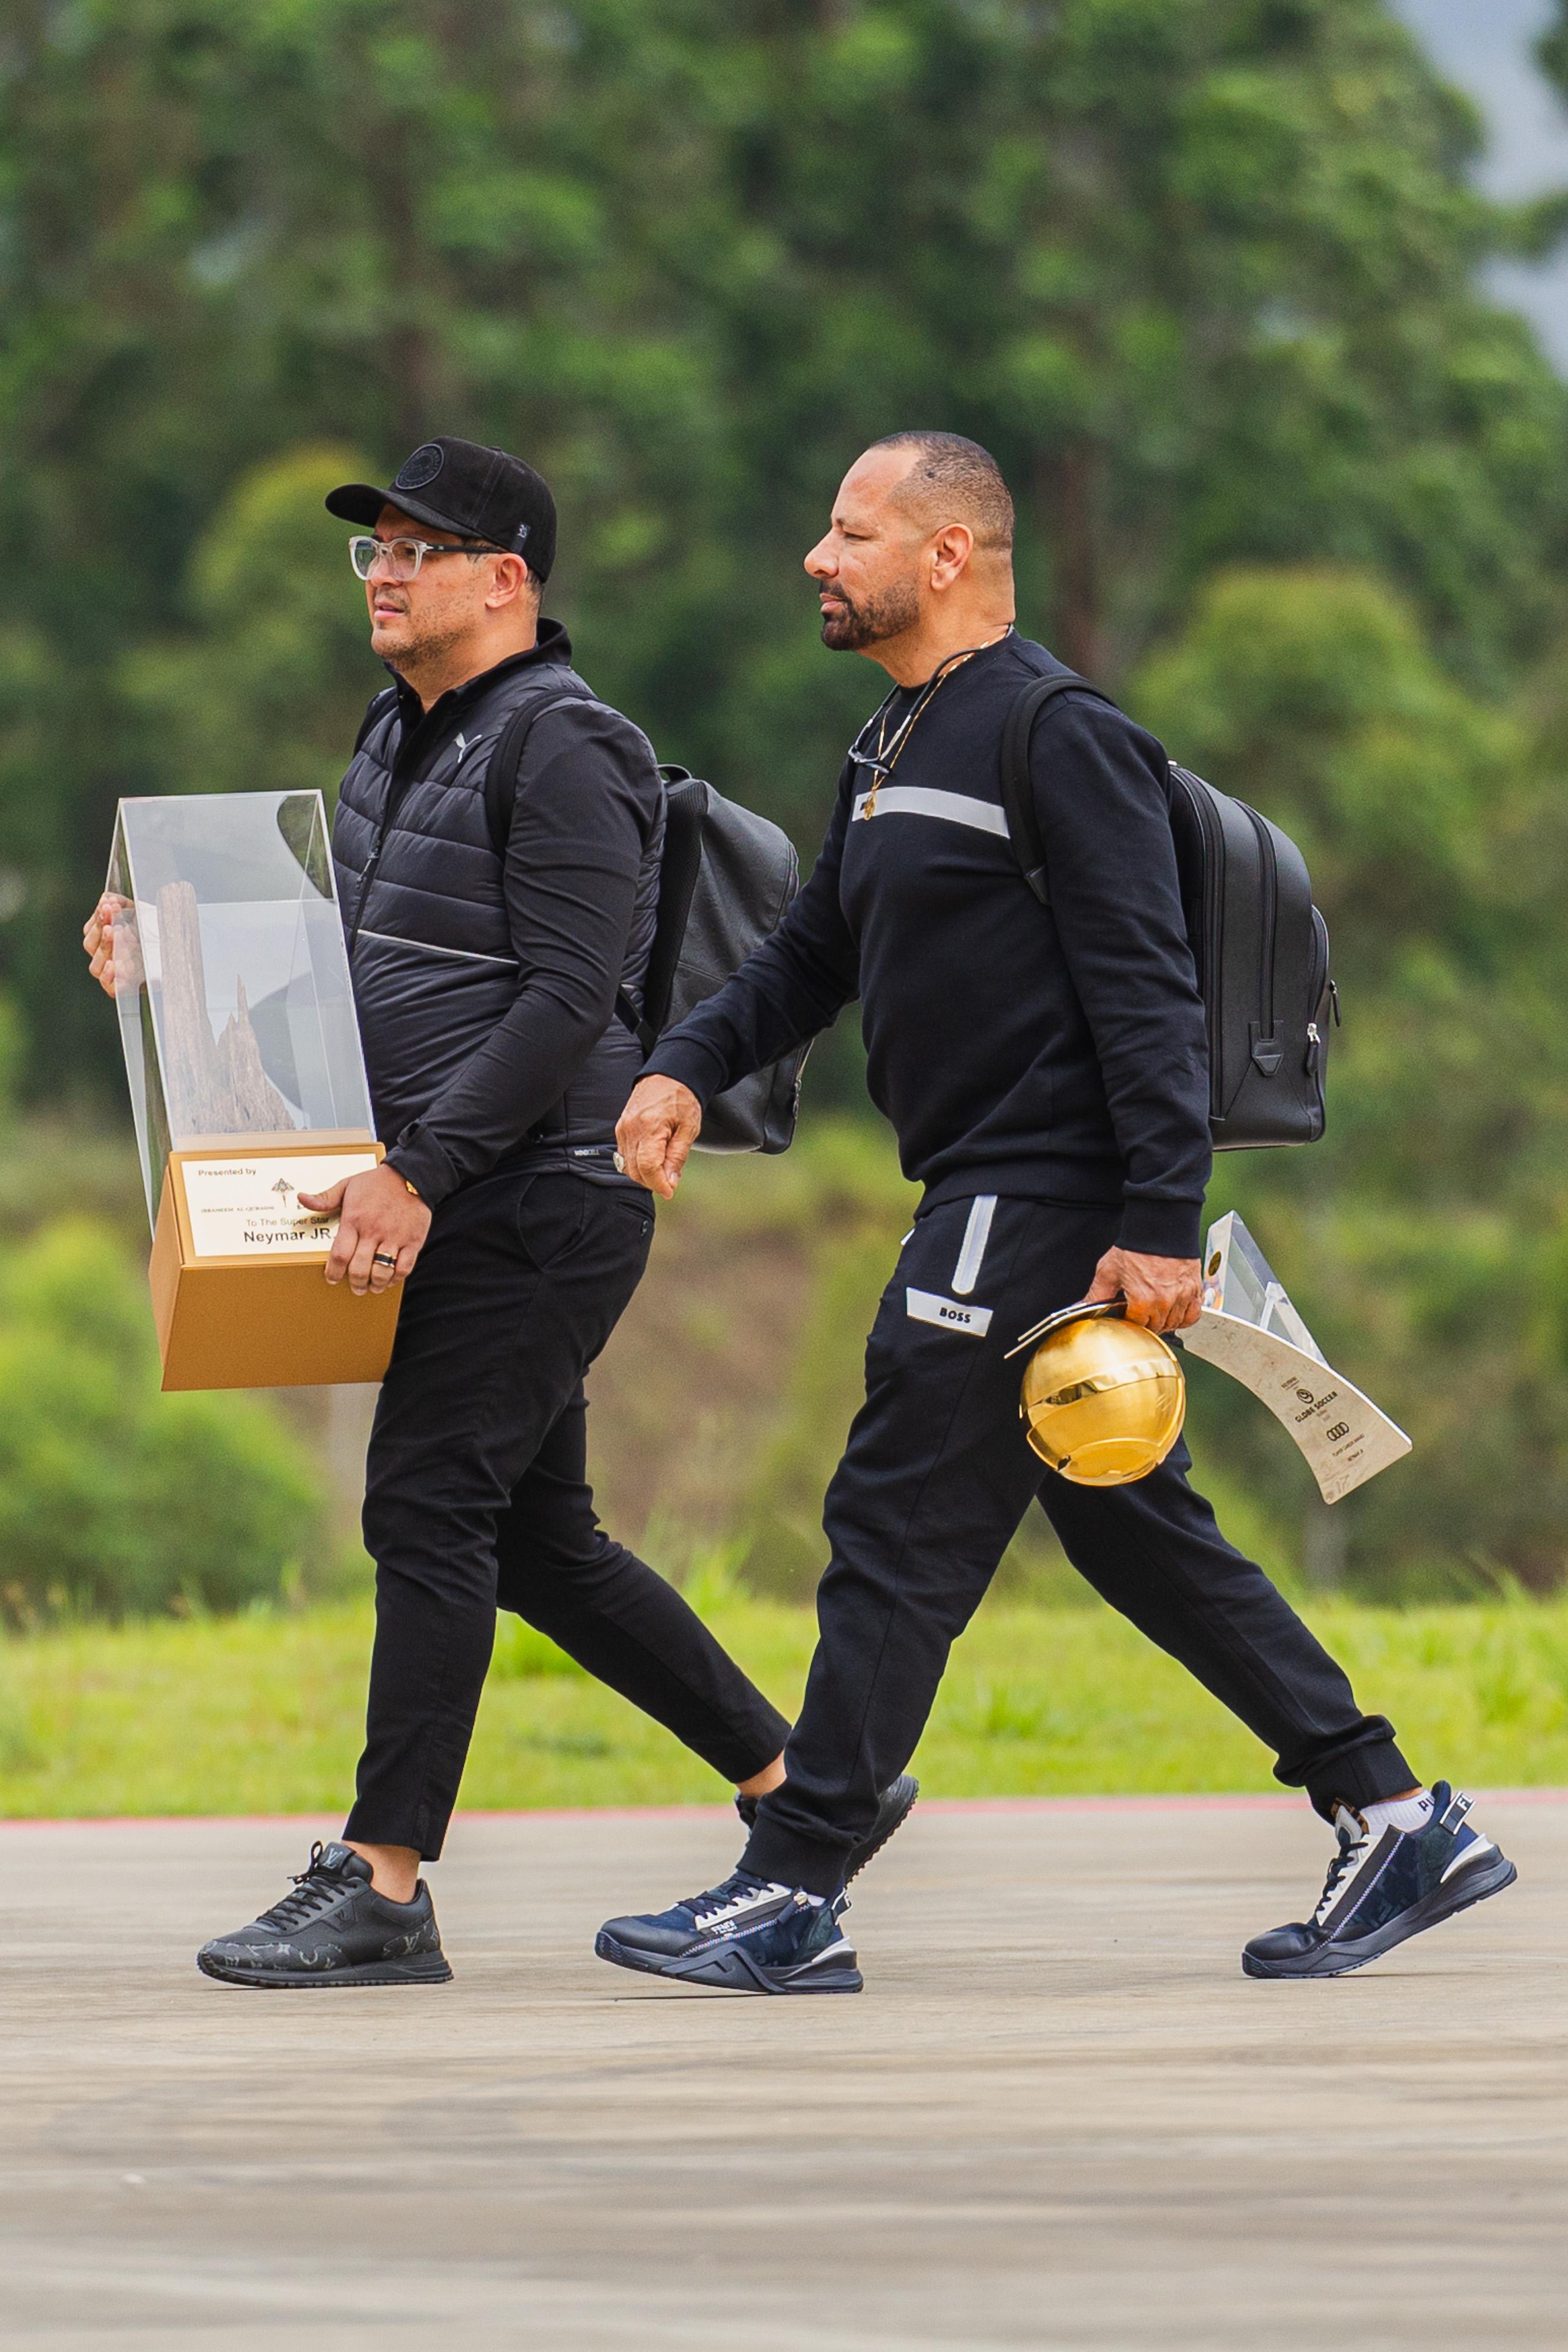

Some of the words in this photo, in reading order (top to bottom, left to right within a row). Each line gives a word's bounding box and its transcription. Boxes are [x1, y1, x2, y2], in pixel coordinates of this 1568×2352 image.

[198, 1168, 243, 1176] Presented
[245, 1168, 256, 1176] by
[280, 1217, 308, 1227] Super
[309, 1216, 329, 1225] Star
[243, 1231, 305, 1245] Neymar
[939, 1307, 971, 1324] BOSS
[1313, 1391, 1338, 1410] SOCCER
